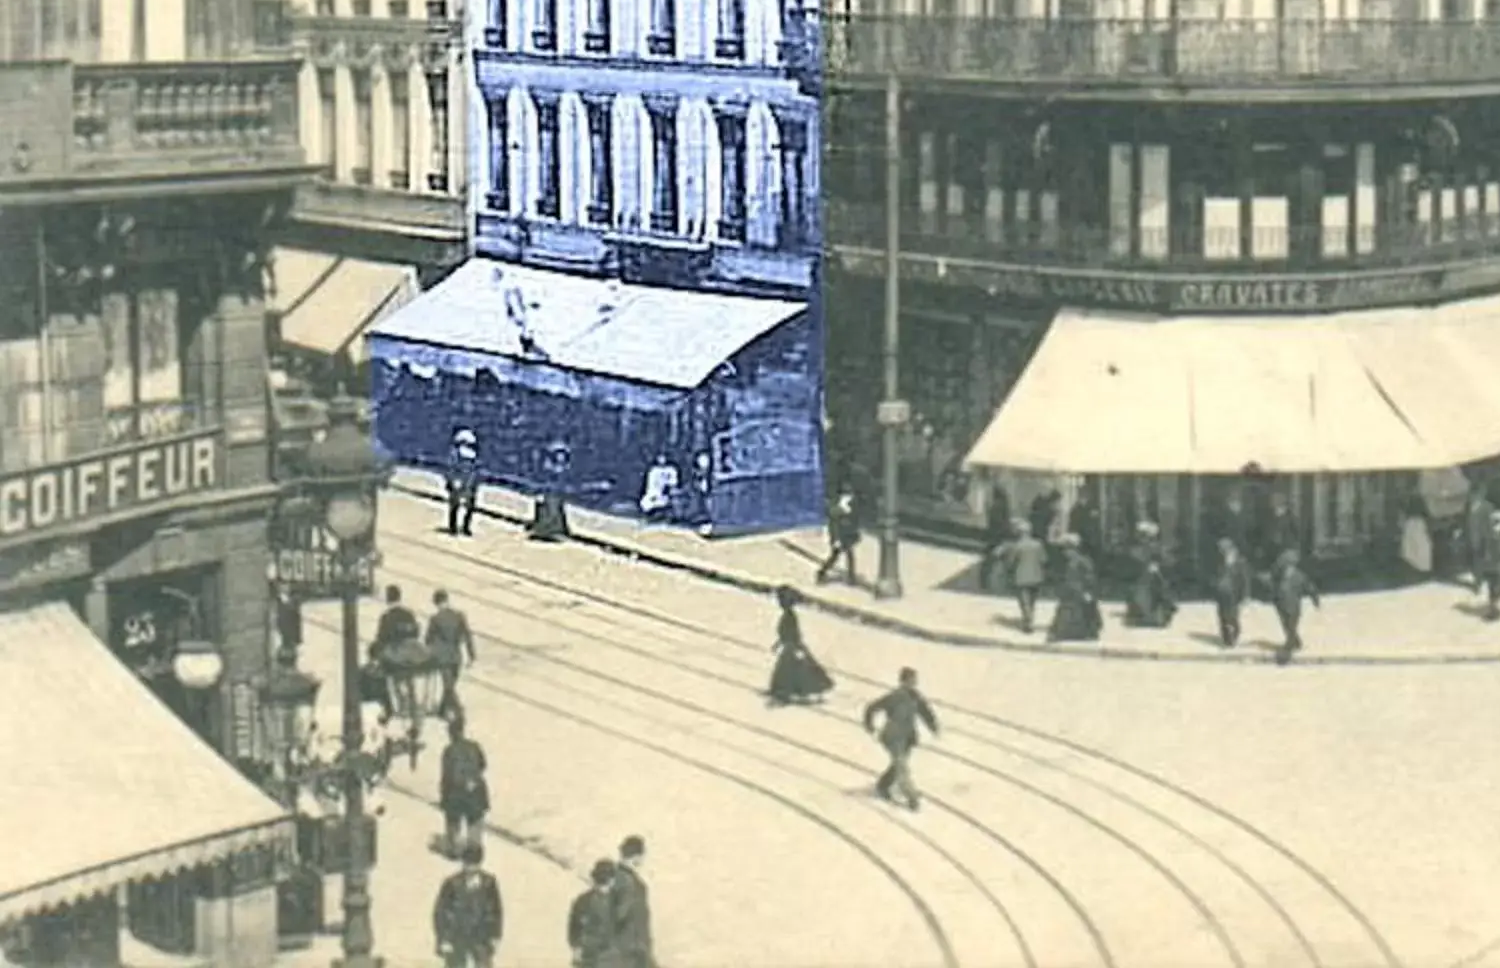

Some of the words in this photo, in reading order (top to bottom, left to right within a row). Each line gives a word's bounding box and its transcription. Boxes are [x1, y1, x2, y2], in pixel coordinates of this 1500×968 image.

[1180, 283, 1319, 308] CRAVATES
[1, 437, 214, 532] COIFFEUR
[280, 550, 369, 586] COIFFR
